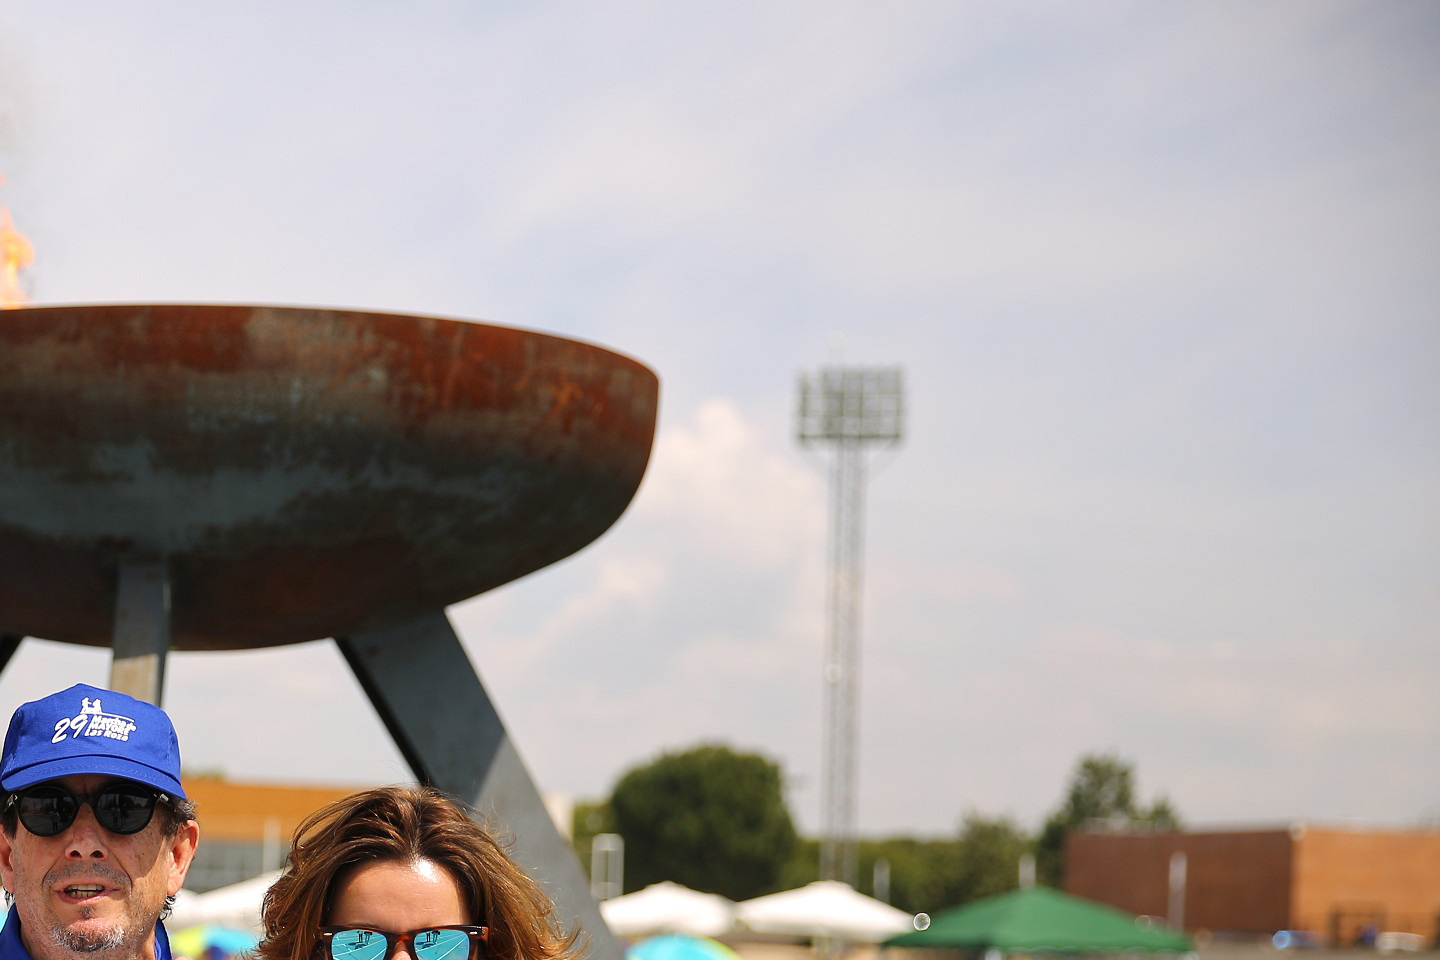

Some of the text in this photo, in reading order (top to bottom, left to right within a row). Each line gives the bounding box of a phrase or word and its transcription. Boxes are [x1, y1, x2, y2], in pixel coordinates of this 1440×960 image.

[52, 714, 88, 743] 29
[90, 721, 129, 735] MAYORE
[103, 730, 129, 742] Roza
